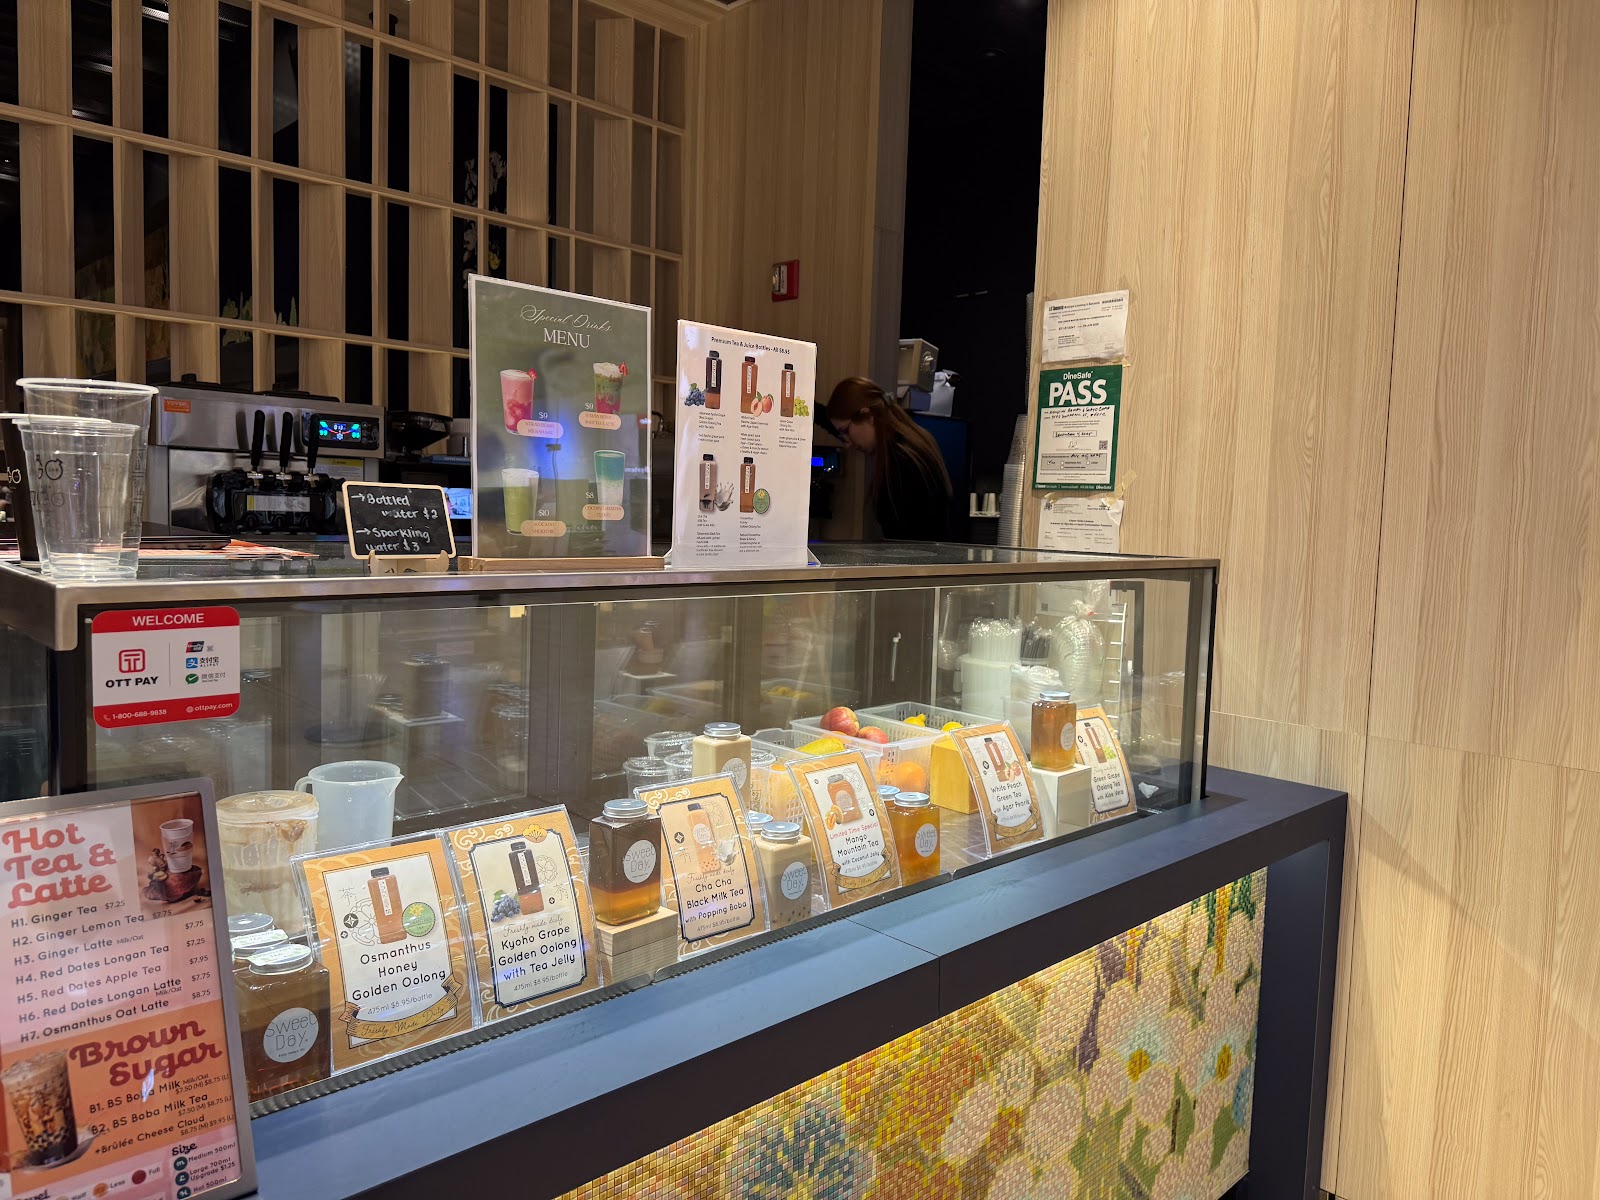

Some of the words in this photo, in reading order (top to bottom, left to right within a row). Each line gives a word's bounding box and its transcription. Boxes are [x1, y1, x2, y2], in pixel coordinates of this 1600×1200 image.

[520, 304, 573, 323] Special
[572, 314, 611, 331] Drinks
[543, 327, 590, 347] MENU
[1063, 371, 1092, 380] DineSafe
[1048, 378, 1107, 406] PASS
[366, 493, 410, 506] Bottled
[423, 507, 437, 519] $2
[365, 541, 400, 551] water
[403, 538, 420, 551] $3
[371, 526, 430, 543] Sparkling
[132, 613, 205, 626] WELCOME
[105, 678, 131, 688] OTT
[135, 675, 158, 686] PAY
[112, 709, 167, 720] 1-800-688-9838
[195, 702, 233, 712] ottpay.com
[990, 784, 1005, 793] White
[1006, 780, 1022, 789] Peach
[996, 793, 1012, 802] Green
[1001, 803, 1014, 811] Agar
[1015, 799, 1029, 807] Pearls
[2, 822, 86, 853] Hot
[845, 833, 867, 844] Mango
[837, 842, 866, 857] Mountain
[867, 839, 878, 847] Tea
[4, 852, 83, 880] Tea
[88, 843, 118, 867] &
[8, 874, 112, 908] Latte
[695, 882, 712, 892] Cha
[715, 878, 731, 887] Cha
[686, 895, 708, 909] Black
[711, 891, 727, 902] Milk
[729, 887, 743, 897] Tea
[11, 916, 27, 928] H1.
[31, 909, 73, 924] Ginger
[77, 904, 97, 915] Tea
[105, 900, 125, 910] $7.25
[698, 907, 727, 920] Popping
[729, 901, 746, 910] Boba
[13, 935, 32, 947] H2.
[36, 927, 77, 943] Ginger
[82, 919, 121, 934] Lemon
[125, 914, 144, 924] Tea
[152, 909, 172, 920] $7.75
[501, 934, 534, 950] Kyoho
[538, 925, 570, 940] Grape
[502, 922, 530, 937] Freshly
[14, 954, 34, 966] H3.
[38, 945, 79, 962] Ginger
[84, 938, 113, 953] Latte
[185, 919, 204, 930] $7.75
[360, 940, 431, 964] Osmanthus
[498, 950, 536, 966] Golden
[540, 938, 576, 954] Oolong
[16, 973, 37, 985] H4.
[40, 966, 62, 979] Red
[68, 960, 100, 974] Dates
[104, 950, 146, 966] Longan
[150, 944, 169, 955] Tea
[187, 937, 206, 947] $7.25
[378, 960, 417, 978] Honey
[503, 966, 525, 981] with
[529, 961, 547, 972] Tea
[551, 953, 575, 967] Jelly
[18, 992, 38, 1004] H5.
[42, 985, 64, 998] Red
[69, 979, 101, 992] Dates
[105, 969, 138, 984] Apple
[142, 964, 161, 975] Tea
[189, 954, 208, 965] $7.95
[352, 981, 397, 1001] Golden
[402, 969, 446, 988] Oolong
[19, 1010, 40, 1022] H6.
[44, 1004, 66, 1017] Red
[71, 998, 103, 1011] Dates
[107, 986, 149, 1002] Longan
[154, 977, 181, 990] Latte
[192, 971, 210, 982] $7.75
[21, 1030, 40, 1043] H7.
[43, 1013, 112, 1037] Osmanthus
[116, 1004, 137, 1018] Oat
[141, 999, 169, 1013] Latte
[192, 988, 210, 1000] $8.75
[367, 1002, 389, 1015] 475ml
[69, 1019, 206, 1068] Brown
[109, 1041, 222, 1086] Sugar
[89, 1102, 104, 1113] B1.
[107, 1095, 123, 1108] BS
[159, 1081, 180, 1094] Milk
[175, 1084, 192, 1094] $7.50
[91, 1124, 109, 1135] B2.
[112, 1117, 127, 1129] BS
[131, 1108, 159, 1124] Boba
[164, 1100, 185, 1112] Milk
[189, 1094, 207, 1104] Tea
[137, 1125, 173, 1141] Cheese
[177, 1114, 204, 1128] Cloud
[172, 1141, 197, 1156] Size
[187, 1150, 213, 1162] Medium
[214, 1142, 235, 1154] 500ml
[189, 1163, 208, 1177] Large
[209, 1156, 230, 1169] 700ml
[190, 1167, 217, 1181] Upgrade
[218, 1161, 235, 1172] $1.25
[192, 1183, 204, 1193] Hot
[205, 1176, 226, 1188] 500ml
